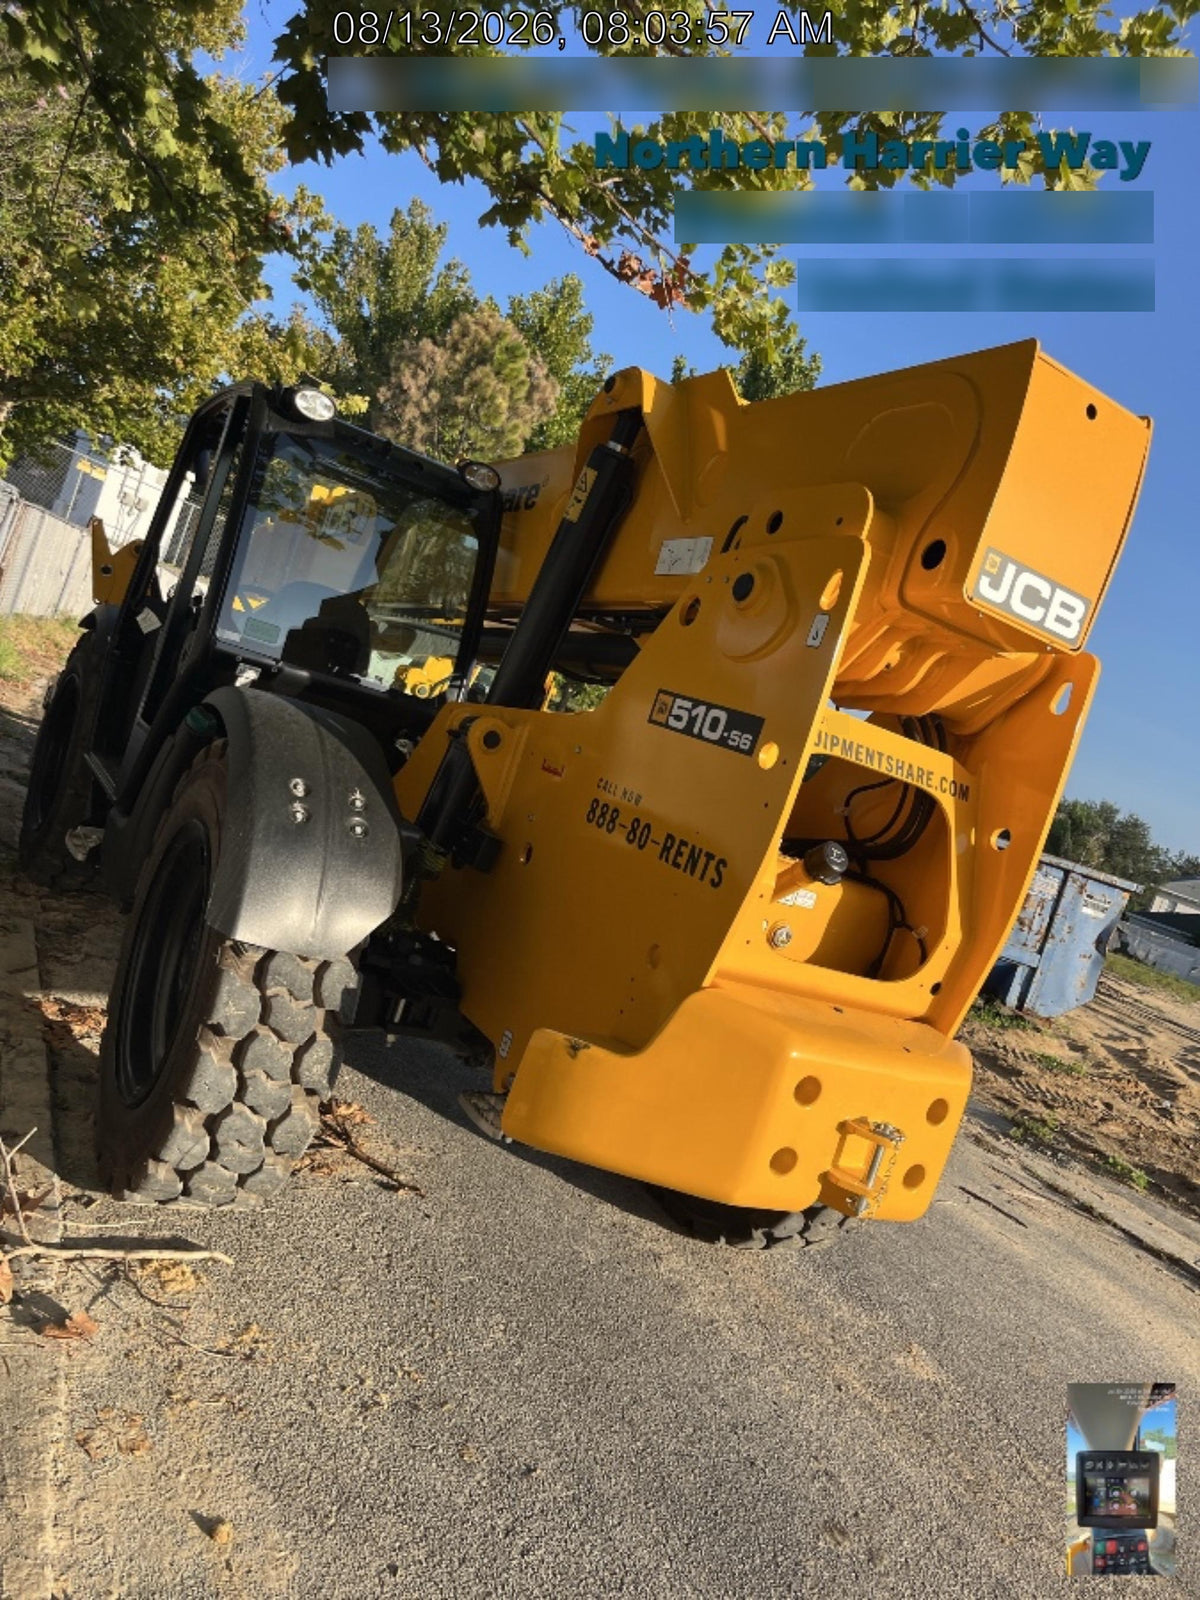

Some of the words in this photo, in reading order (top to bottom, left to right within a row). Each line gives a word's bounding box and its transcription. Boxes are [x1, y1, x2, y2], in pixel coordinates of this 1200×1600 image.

[979, 562, 1086, 640] JCB
[597, 777, 618, 797] CALL
[586, 797, 728, 889] 888-80-RENTS
